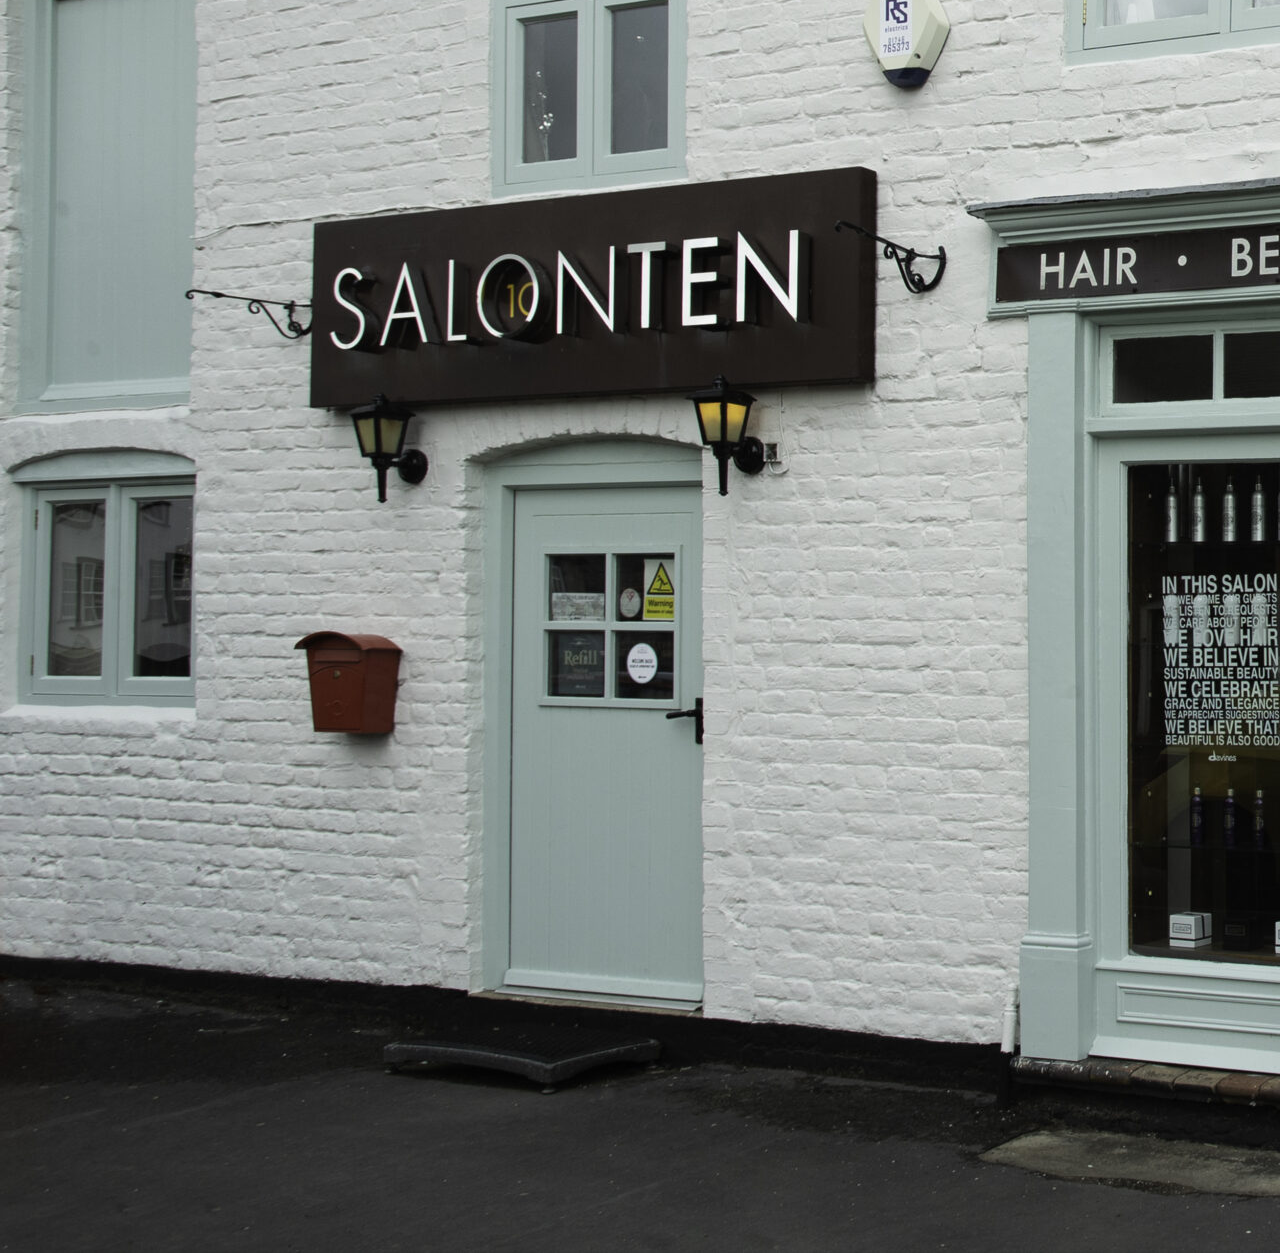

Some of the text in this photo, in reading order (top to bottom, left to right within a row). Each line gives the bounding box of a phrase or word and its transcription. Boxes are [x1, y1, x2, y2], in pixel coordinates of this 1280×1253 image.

[1039, 246, 1138, 290] HAIR
[1162, 573, 1278, 594] IN THIS SALON
[648, 599, 674, 609] Warning
[1178, 594, 1220, 605] WELOME
[1243, 593, 1277, 603] GUSTS
[1213, 605, 1225, 615] TO
[1179, 617, 1205, 628] CARE
[1206, 617, 1238, 628] ABOUT
[1241, 616, 1277, 627] PEOPLE
[1240, 628, 1278, 646] HAIR
[564, 649, 598, 666] Refill
[1163, 647, 1279, 667] WE BELIEVE IN
[1163, 667, 1279, 680] SUSTAINABLE BEAUTY
[1164, 681, 1280, 698] WE CELEBRATE
[1164, 698, 1280, 710] GRACE AND ELEGANCE
[1164, 710, 1280, 720] WE APPRECIATE SUGGESTIONS
[1165, 720, 1280, 735] WE BELIEVE THAT
[1165, 734, 1280, 746] BEAUTIFUL IS ALSO GOOD
